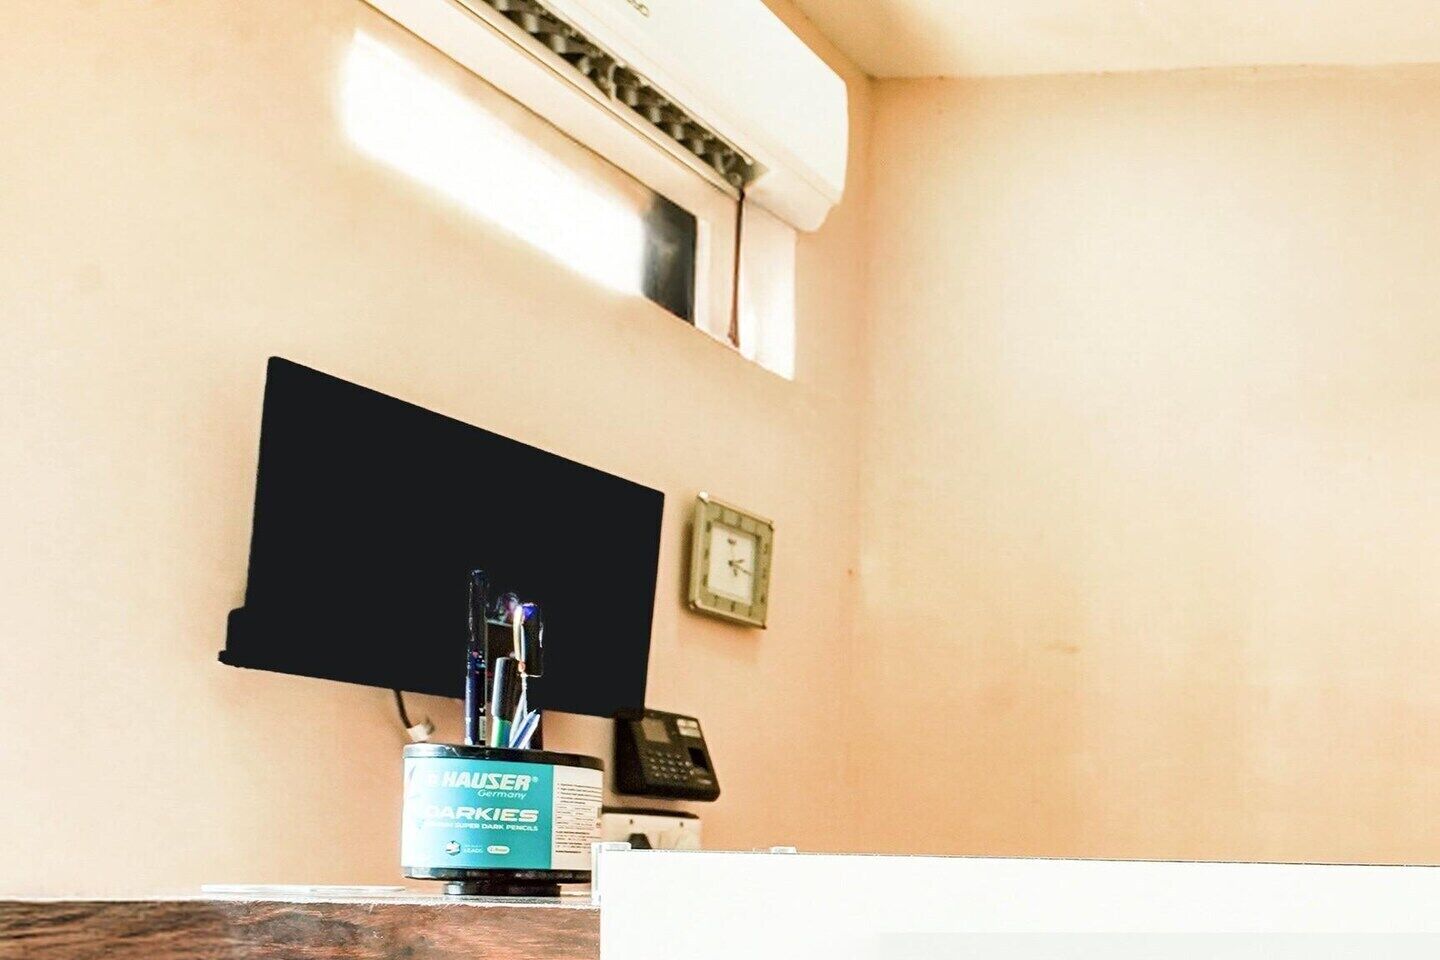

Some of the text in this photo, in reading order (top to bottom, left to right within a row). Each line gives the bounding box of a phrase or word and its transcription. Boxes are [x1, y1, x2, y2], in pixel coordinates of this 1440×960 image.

[441, 771, 531, 791] HAUSER
[477, 789, 527, 800] Germany
[425, 804, 540, 823] DARKIES
[454, 822, 480, 830] SUPER
[481, 823, 504, 831] DARK
[505, 824, 539, 832] PENCILS
